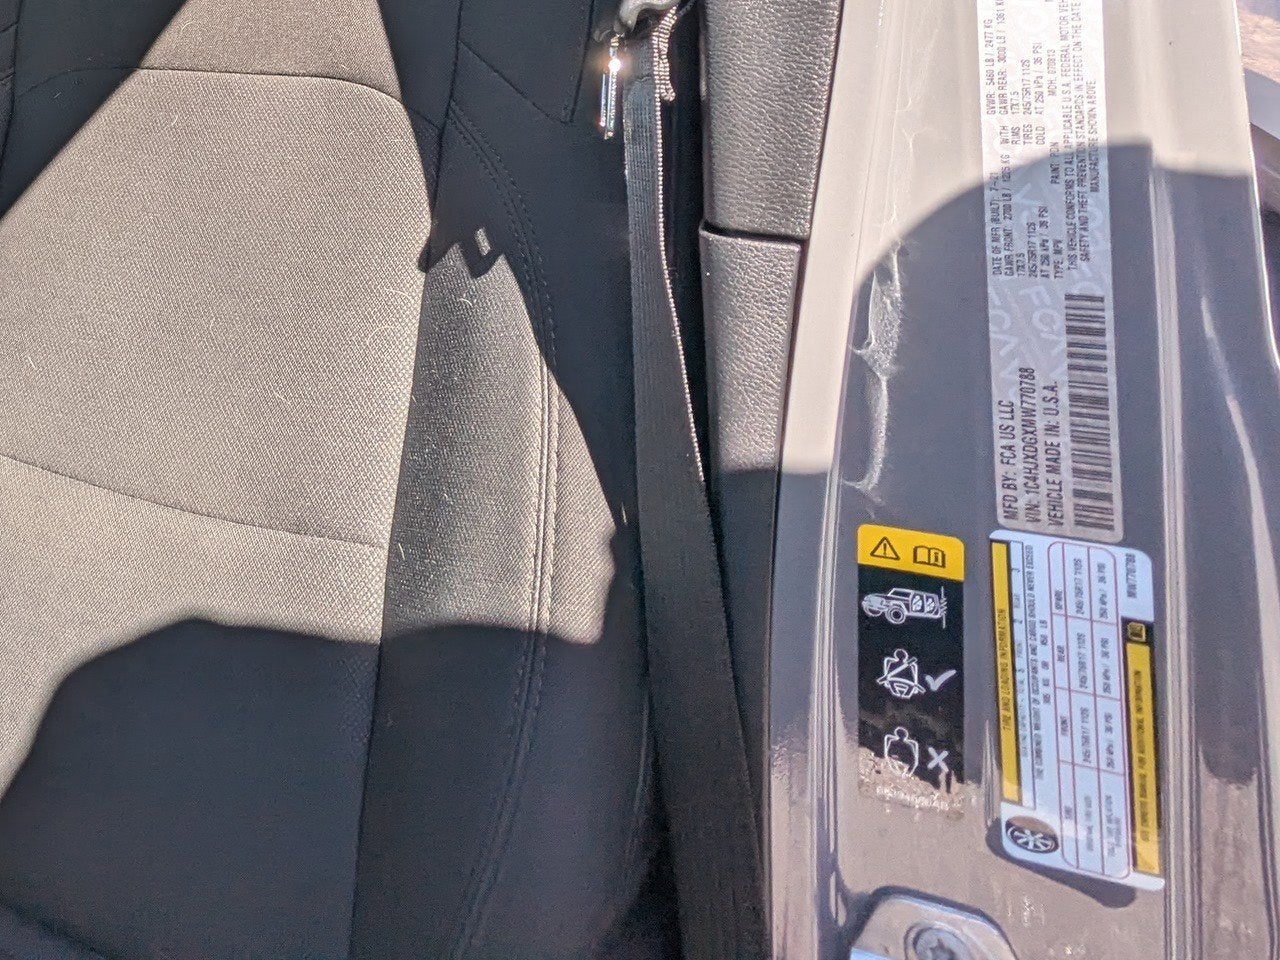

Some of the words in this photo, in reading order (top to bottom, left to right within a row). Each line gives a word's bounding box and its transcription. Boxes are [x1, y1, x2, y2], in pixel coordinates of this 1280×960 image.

[996, 9, 1005, 24] 1361
[1071, 2, 1081, 21] DATE
[983, 19, 992, 28] KG
[1059, 15, 1070, 41] MOTOR
[1072, 24, 1082, 38] THE
[984, 32, 994, 48] 2477
[996, 36, 1006, 44] LB
[1032, 42, 1042, 54] PSI
[1072, 41, 1082, 51] ON
[985, 58, 994, 66] LB
[997, 47, 1006, 63] 3000
[1060, 44, 1070, 76] FEDERAL
[1020, 60, 1030, 76] 112S
[1073, 54, 1083, 81] EFFECT
[986, 69, 995, 86] 5460
[998, 68, 1007, 90] REAR:
[986, 91, 996, 115] GVWR:
[998, 93, 1008, 115] GAWR
[1034, 91, 1044, 104] 250
[1034, 107, 1044, 115] AT
[1074, 94, 1085, 139] STANDARDS
[1088, 107, 1098, 134] SHOWN
[1000, 126, 1010, 145] WITH
[1011, 126, 1021, 145] RIMS
[1023, 124, 1033, 145] TIRES
[1036, 126, 1046, 145] COLD
[1062, 105, 1073, 149] APPLICABLE
[1000, 154, 1010, 164] KG
[1064, 153, 1074, 164] ALL
[1076, 142, 1087, 187] PREVENTION
[1064, 167, 1074, 176] TO
[1002, 193, 1012, 201] LB
[1064, 179, 1076, 220] CONFORMS
[1078, 191, 1088, 214] THEFT
[1038, 206, 1048, 218] PSI
[1078, 216, 1089, 232] AND
[991, 227, 1001, 242] MFR
[1066, 222, 1076, 251] VEHICLE
[991, 246, 1001, 254] OF
[1079, 234, 1090, 262] SAFETY
[992, 257, 1002, 274] DATE
[1004, 254, 1014, 276] GAWR
[1068, 254, 1078, 270] THIS
[1040, 270, 1050, 278] AT
[1042, 380, 1058, 416] U.S.A.
[998, 400, 1014, 420] LLC
[999, 424, 1015, 440] US
[1018, 367, 1040, 494] 1C4HJXDGXMW770788
[1043, 420, 1060, 437] IN:
[1000, 444, 1016, 465] FCA
[1044, 440, 1062, 475] MADE
[1002, 471, 1017, 490] BY:
[1002, 495, 1018, 520] MFD
[1024, 499, 1041, 522] VIN:
[1045, 477, 1063, 526] VEHICLE
[998, 608, 1008, 660] INFORMATION
